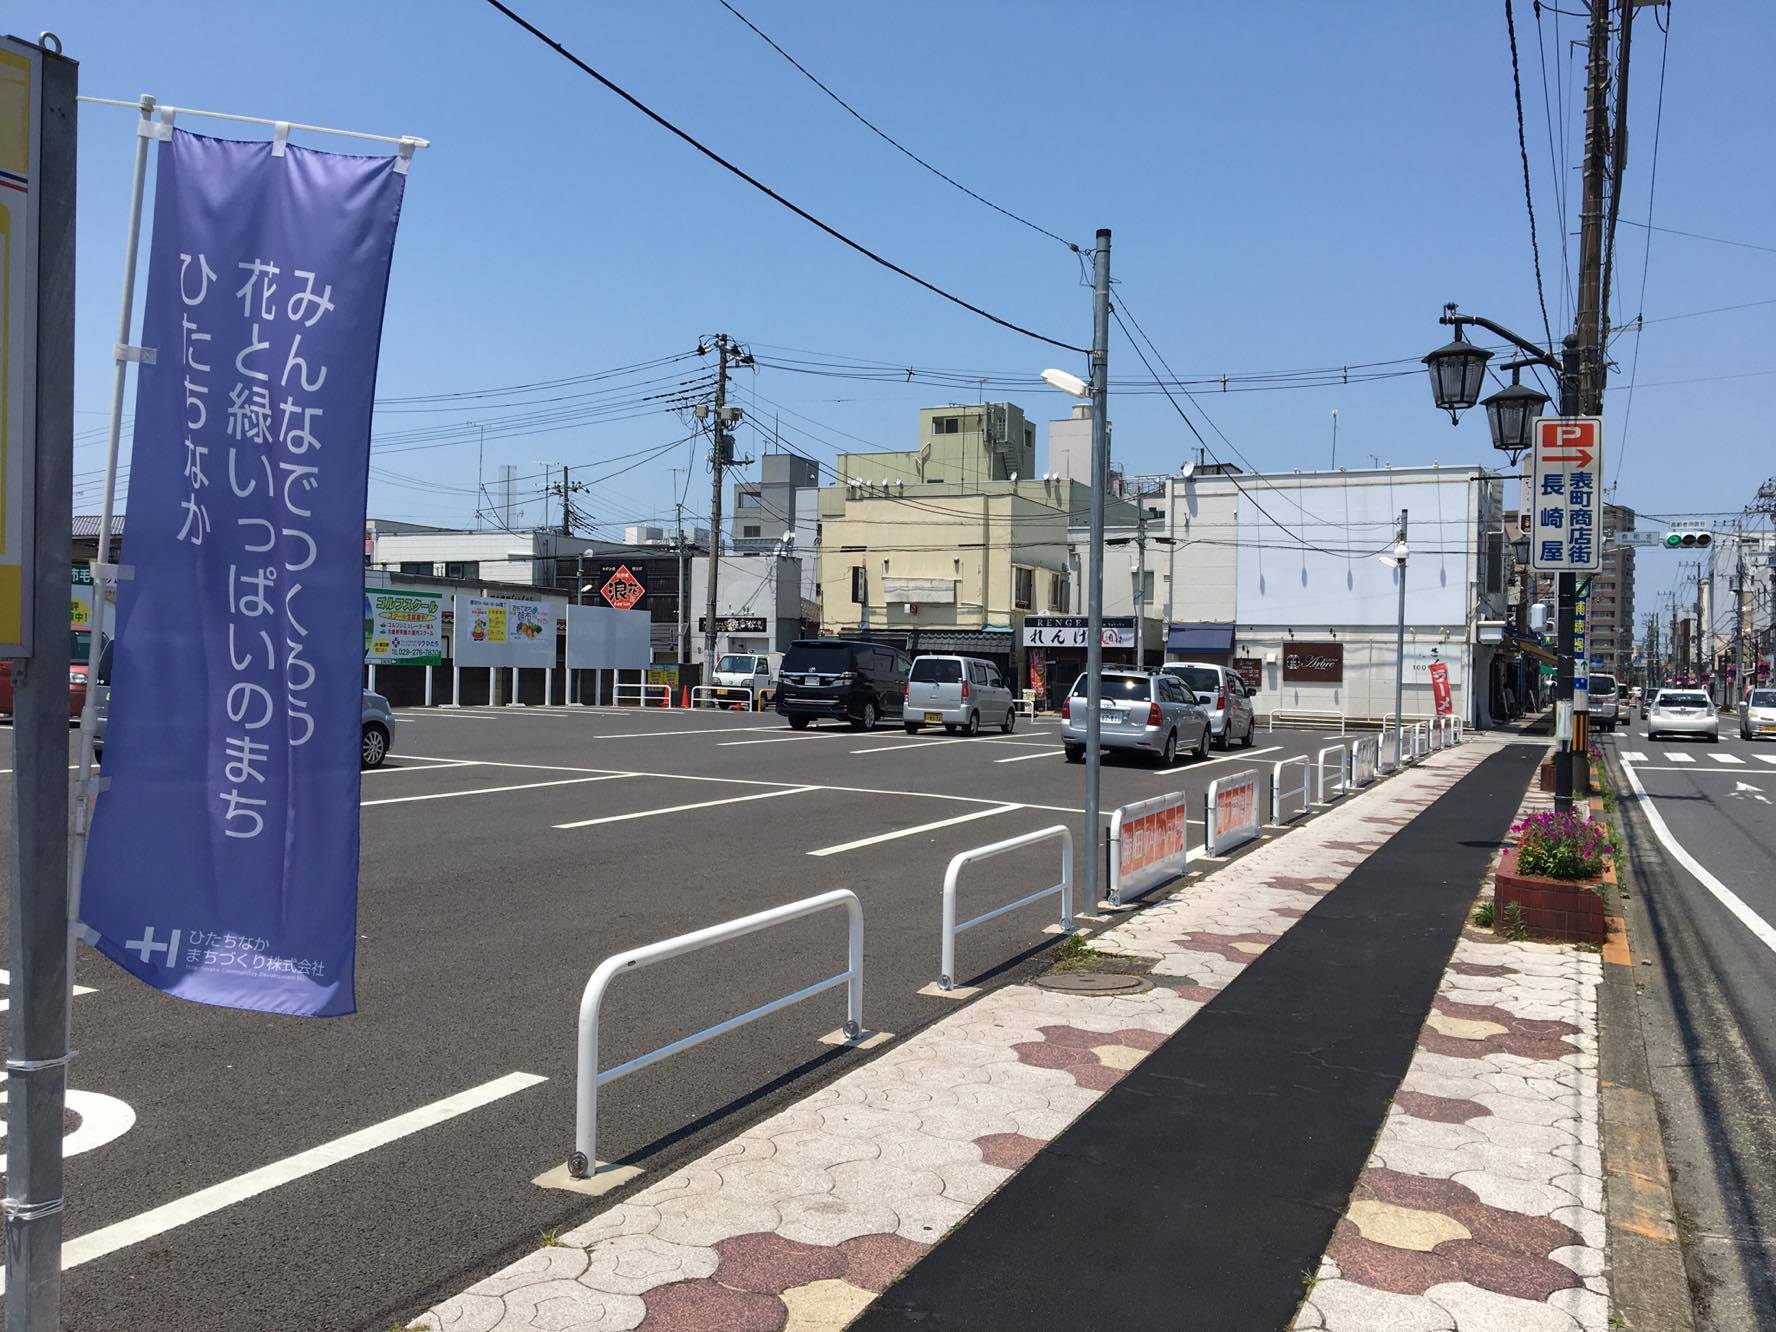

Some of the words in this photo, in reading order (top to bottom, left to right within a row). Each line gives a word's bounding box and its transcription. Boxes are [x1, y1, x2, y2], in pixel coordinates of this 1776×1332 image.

[176, 252, 217, 547] ひたちなか
[219, 259, 280, 839] 花と緑いっぱいのまち
[279, 270, 335, 746] みんなでつくろう
[1540, 473, 1565, 562] 長崎屋
[1568, 471, 1594, 565] 表町商店街
[375, 596, 439, 614] ゴルフスクール
[1037, 618, 1083, 627] RENGE
[186, 947, 326, 978] まちづくり株式会社
[189, 929, 270, 953] ひたちなか
